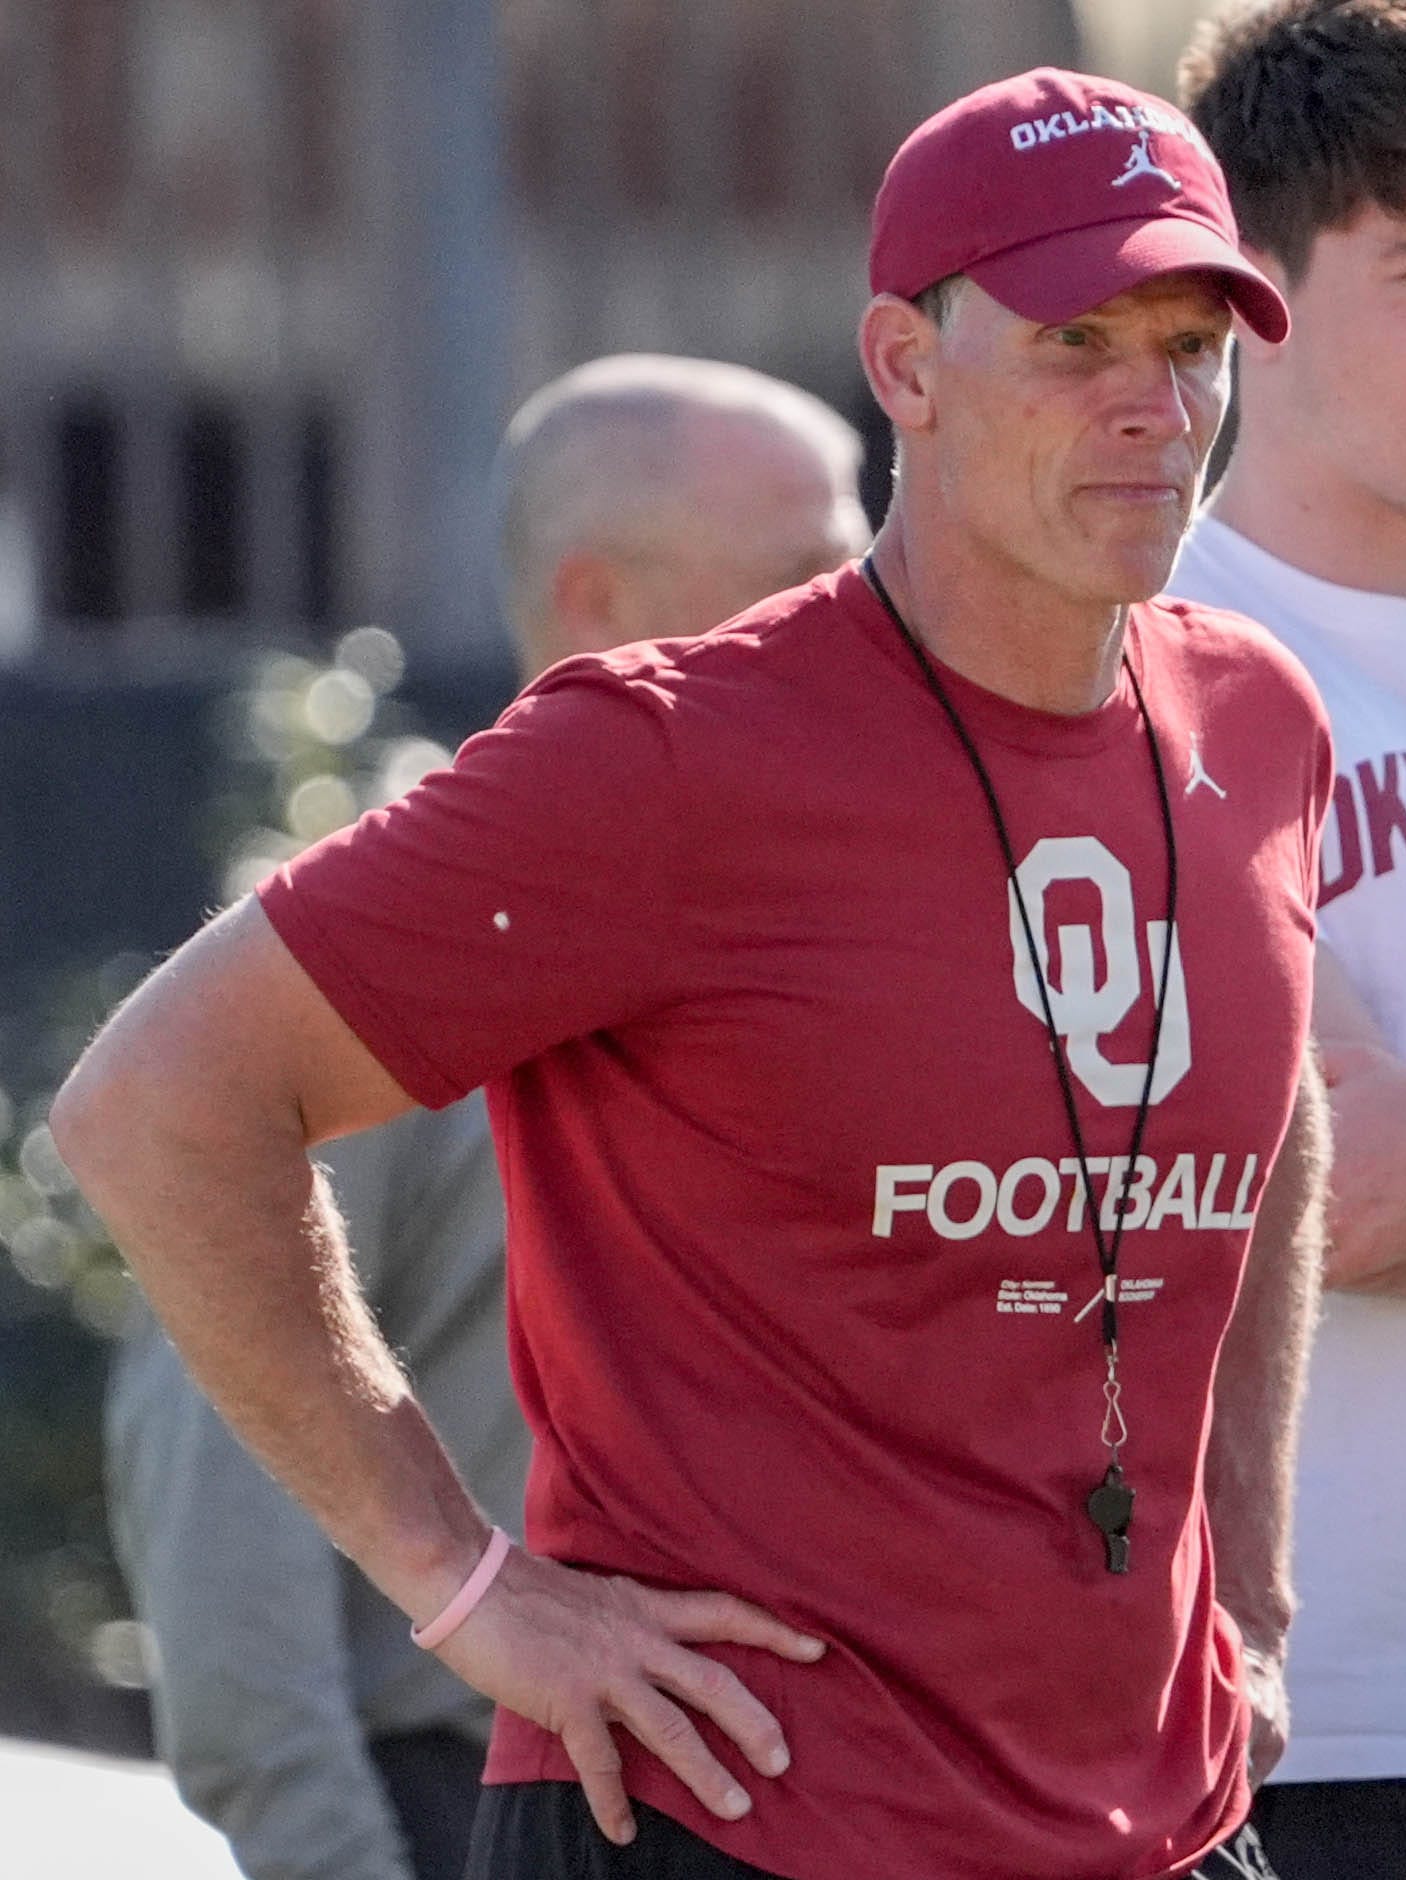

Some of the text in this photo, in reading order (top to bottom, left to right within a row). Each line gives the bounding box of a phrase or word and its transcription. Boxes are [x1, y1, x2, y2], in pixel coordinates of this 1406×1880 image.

[1010, 105, 1215, 163] OKLAH
[1008, 836, 1191, 1107] OU
[872, 1153, 1258, 1240] FOOTBALL
